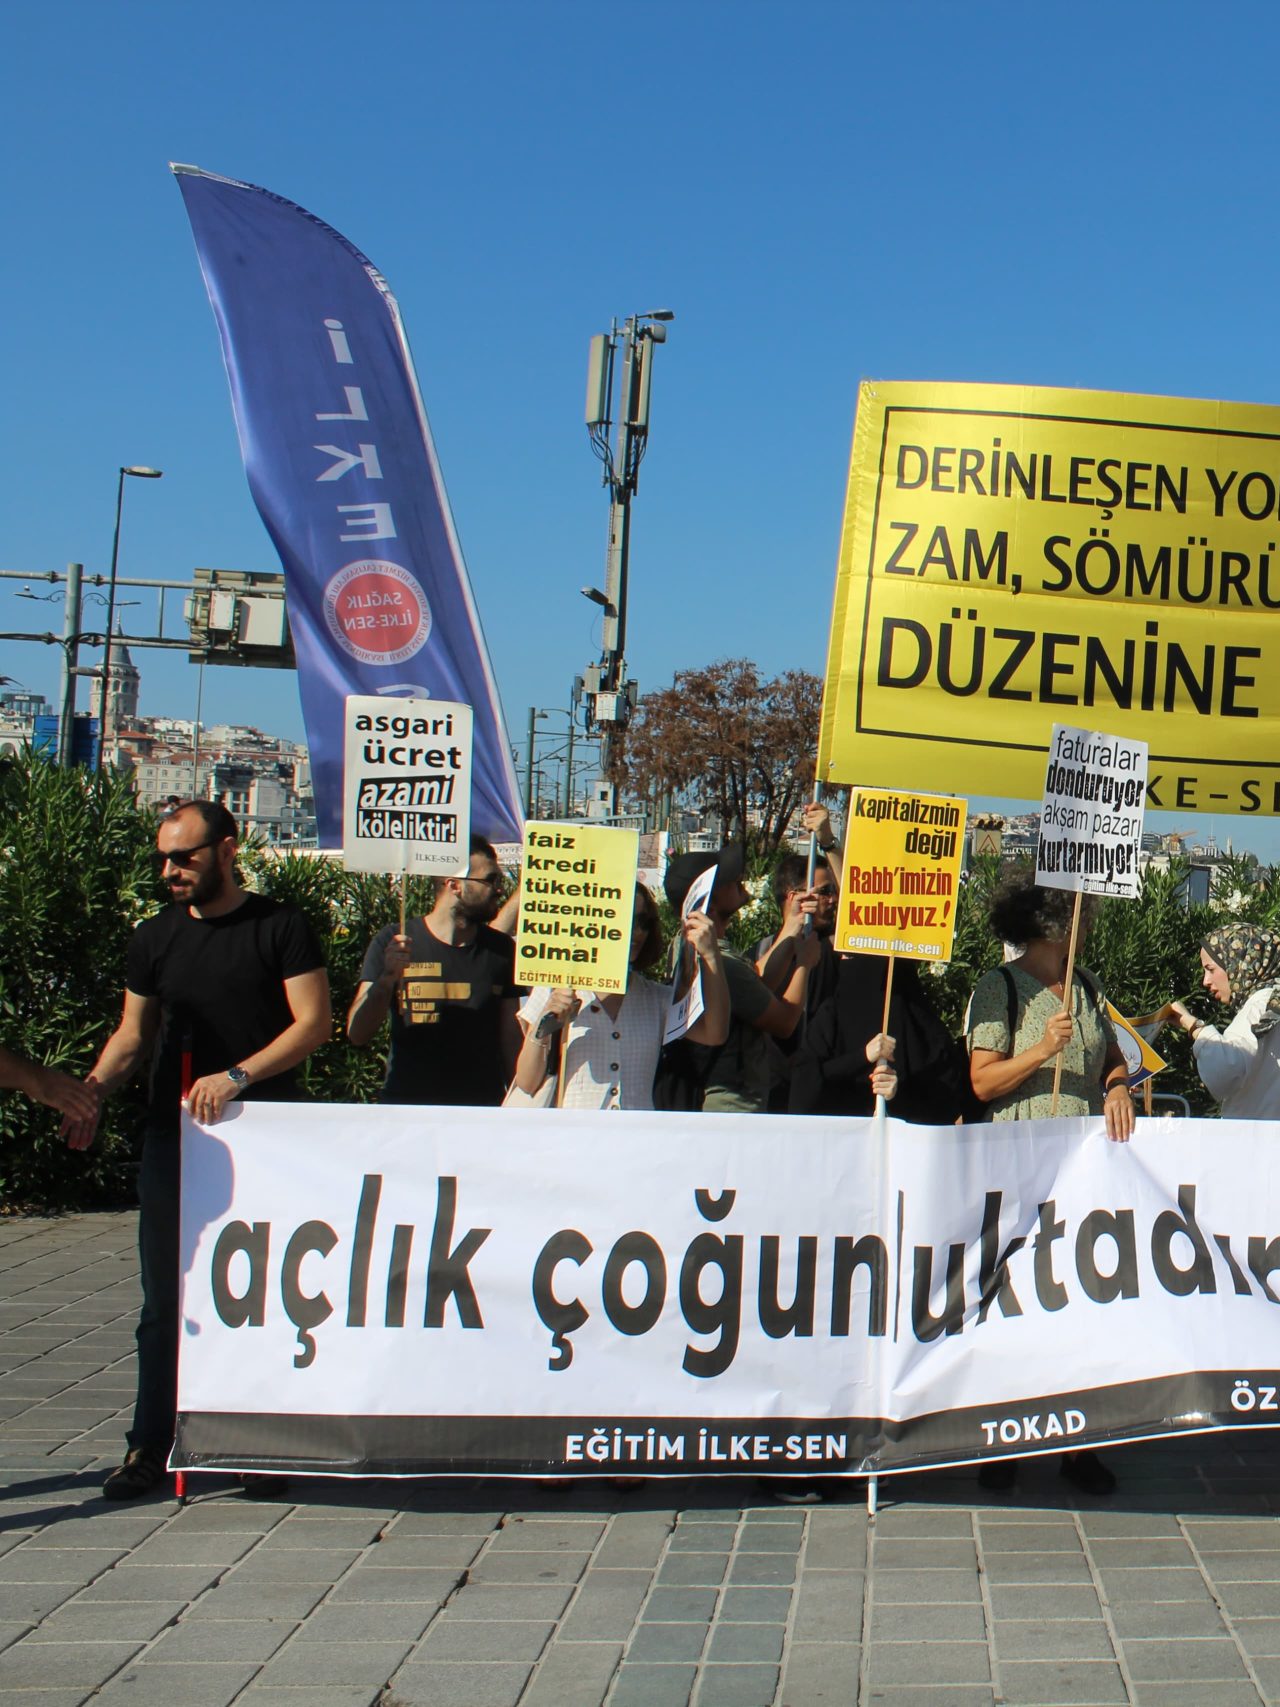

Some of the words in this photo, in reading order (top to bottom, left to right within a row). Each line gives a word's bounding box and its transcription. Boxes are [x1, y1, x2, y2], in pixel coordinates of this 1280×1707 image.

[897, 438, 1188, 520] DERİNLEŞEN
[885, 522, 1022, 595] ZAM,
[878, 607, 1262, 718] DÜZENİNE
[356, 714, 453, 738] asgari
[363, 740, 461, 769] ücret
[1057, 730, 1141, 772] faturalar
[1047, 759, 1144, 812] donduruyor
[855, 793, 960, 827] kapitalizmin
[1044, 803, 1088, 832] akşam
[1093, 812, 1140, 838] pazarı
[358, 811, 456, 842] köleliktir!
[528, 832, 575, 849] faiz
[415, 853, 460, 863] İLKE-SEN
[905, 828, 956, 860] değil
[527, 855, 596, 874] kredi
[525, 879, 622, 899] tüketim
[850, 866, 952, 896] Rabb'imizin
[524, 900, 616, 919] düzenine
[523, 920, 622, 940] kul-köle
[521, 943, 598, 963] olma!
[848, 935, 887, 952] eğitim
[890, 938, 941, 956] ilke-sen
[519, 972, 562, 985] EĞİTİM
[566, 974, 620, 988] İLKE-SEN
[210, 1174, 493, 1369] açlık
[981, 1408, 1087, 1448] TOKAD
[565, 1427, 685, 1463] EĞİTİM
[696, 1427, 848, 1462] İLKE-SEN
